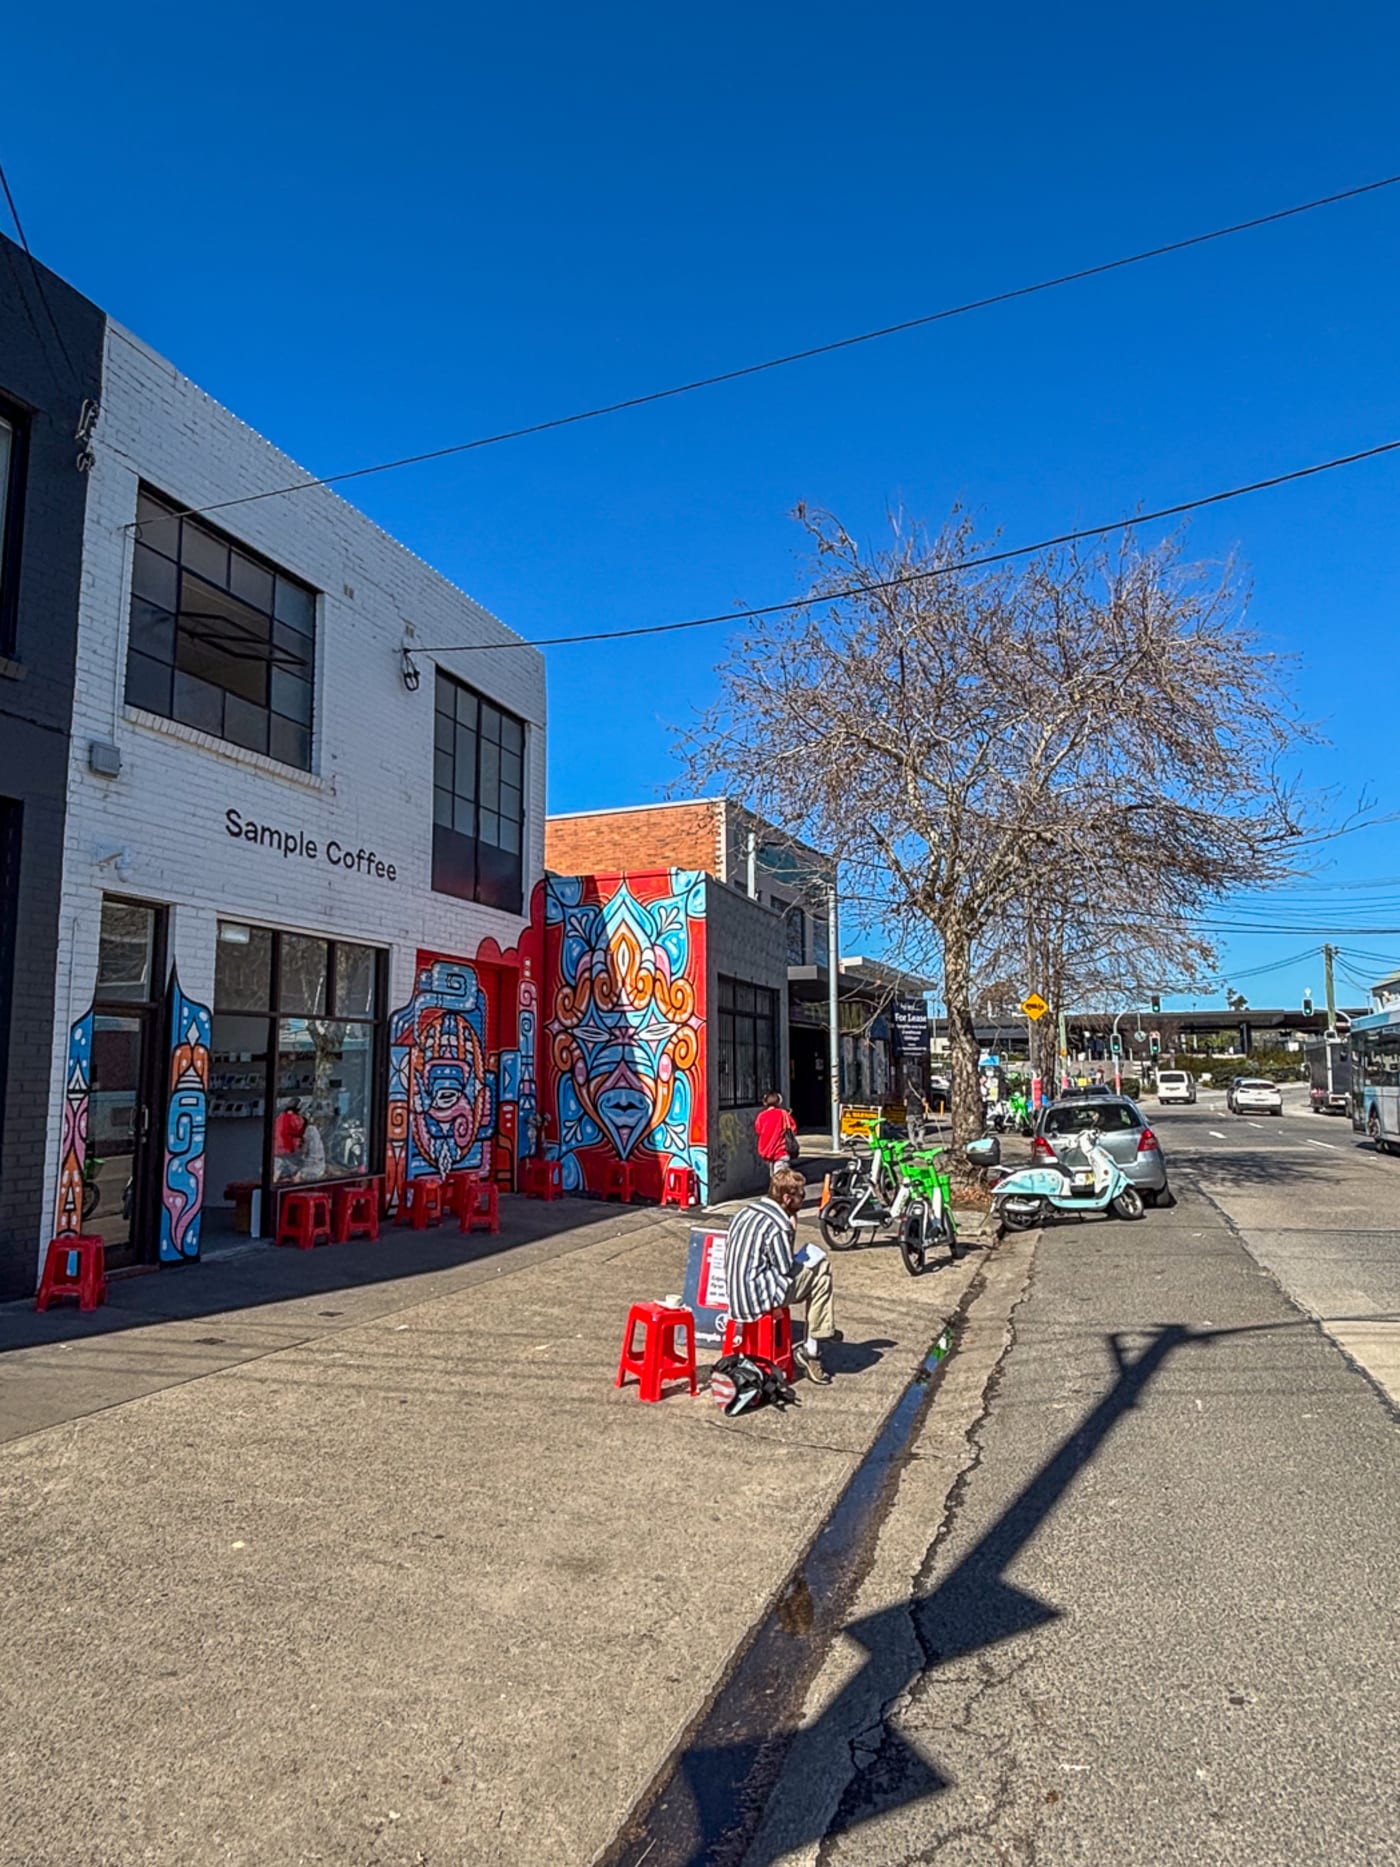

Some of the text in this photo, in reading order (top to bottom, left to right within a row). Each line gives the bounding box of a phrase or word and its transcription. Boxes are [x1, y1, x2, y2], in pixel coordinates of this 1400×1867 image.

[225, 808, 397, 881] Sample Coffee
[895, 1012, 927, 1022] For Lease
